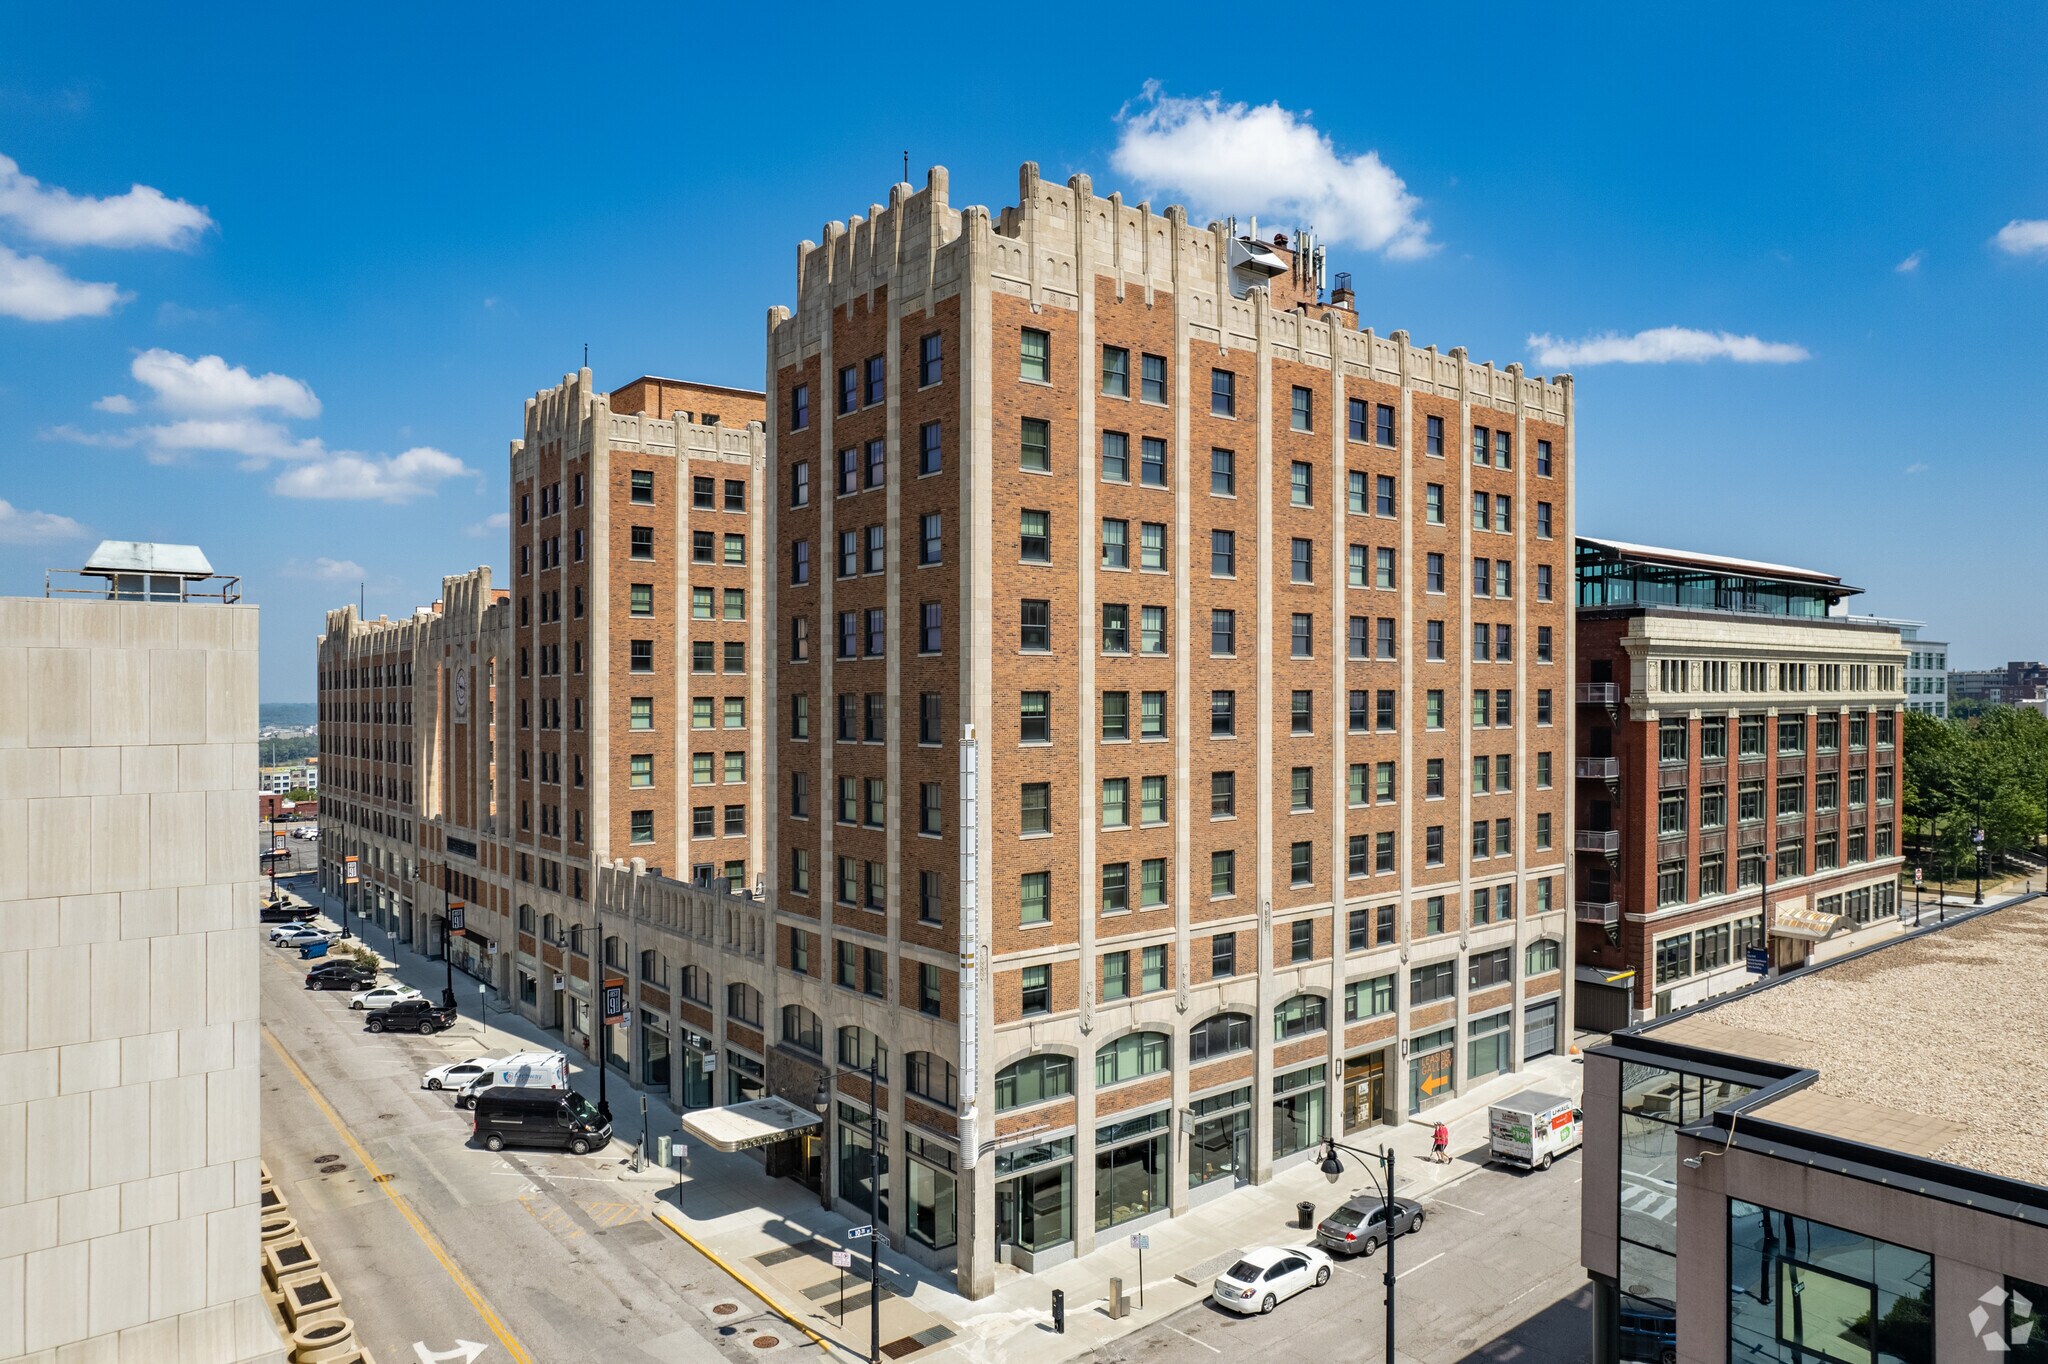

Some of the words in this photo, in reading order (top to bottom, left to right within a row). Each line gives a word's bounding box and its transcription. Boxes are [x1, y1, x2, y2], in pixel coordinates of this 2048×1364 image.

[609, 998, 616, 1014] 9
[1421, 1049, 1451, 1067] LEASING
[1421, 1058, 1453, 1076] GALLERY
[1552, 1104, 1570, 1116] U-HAUL
